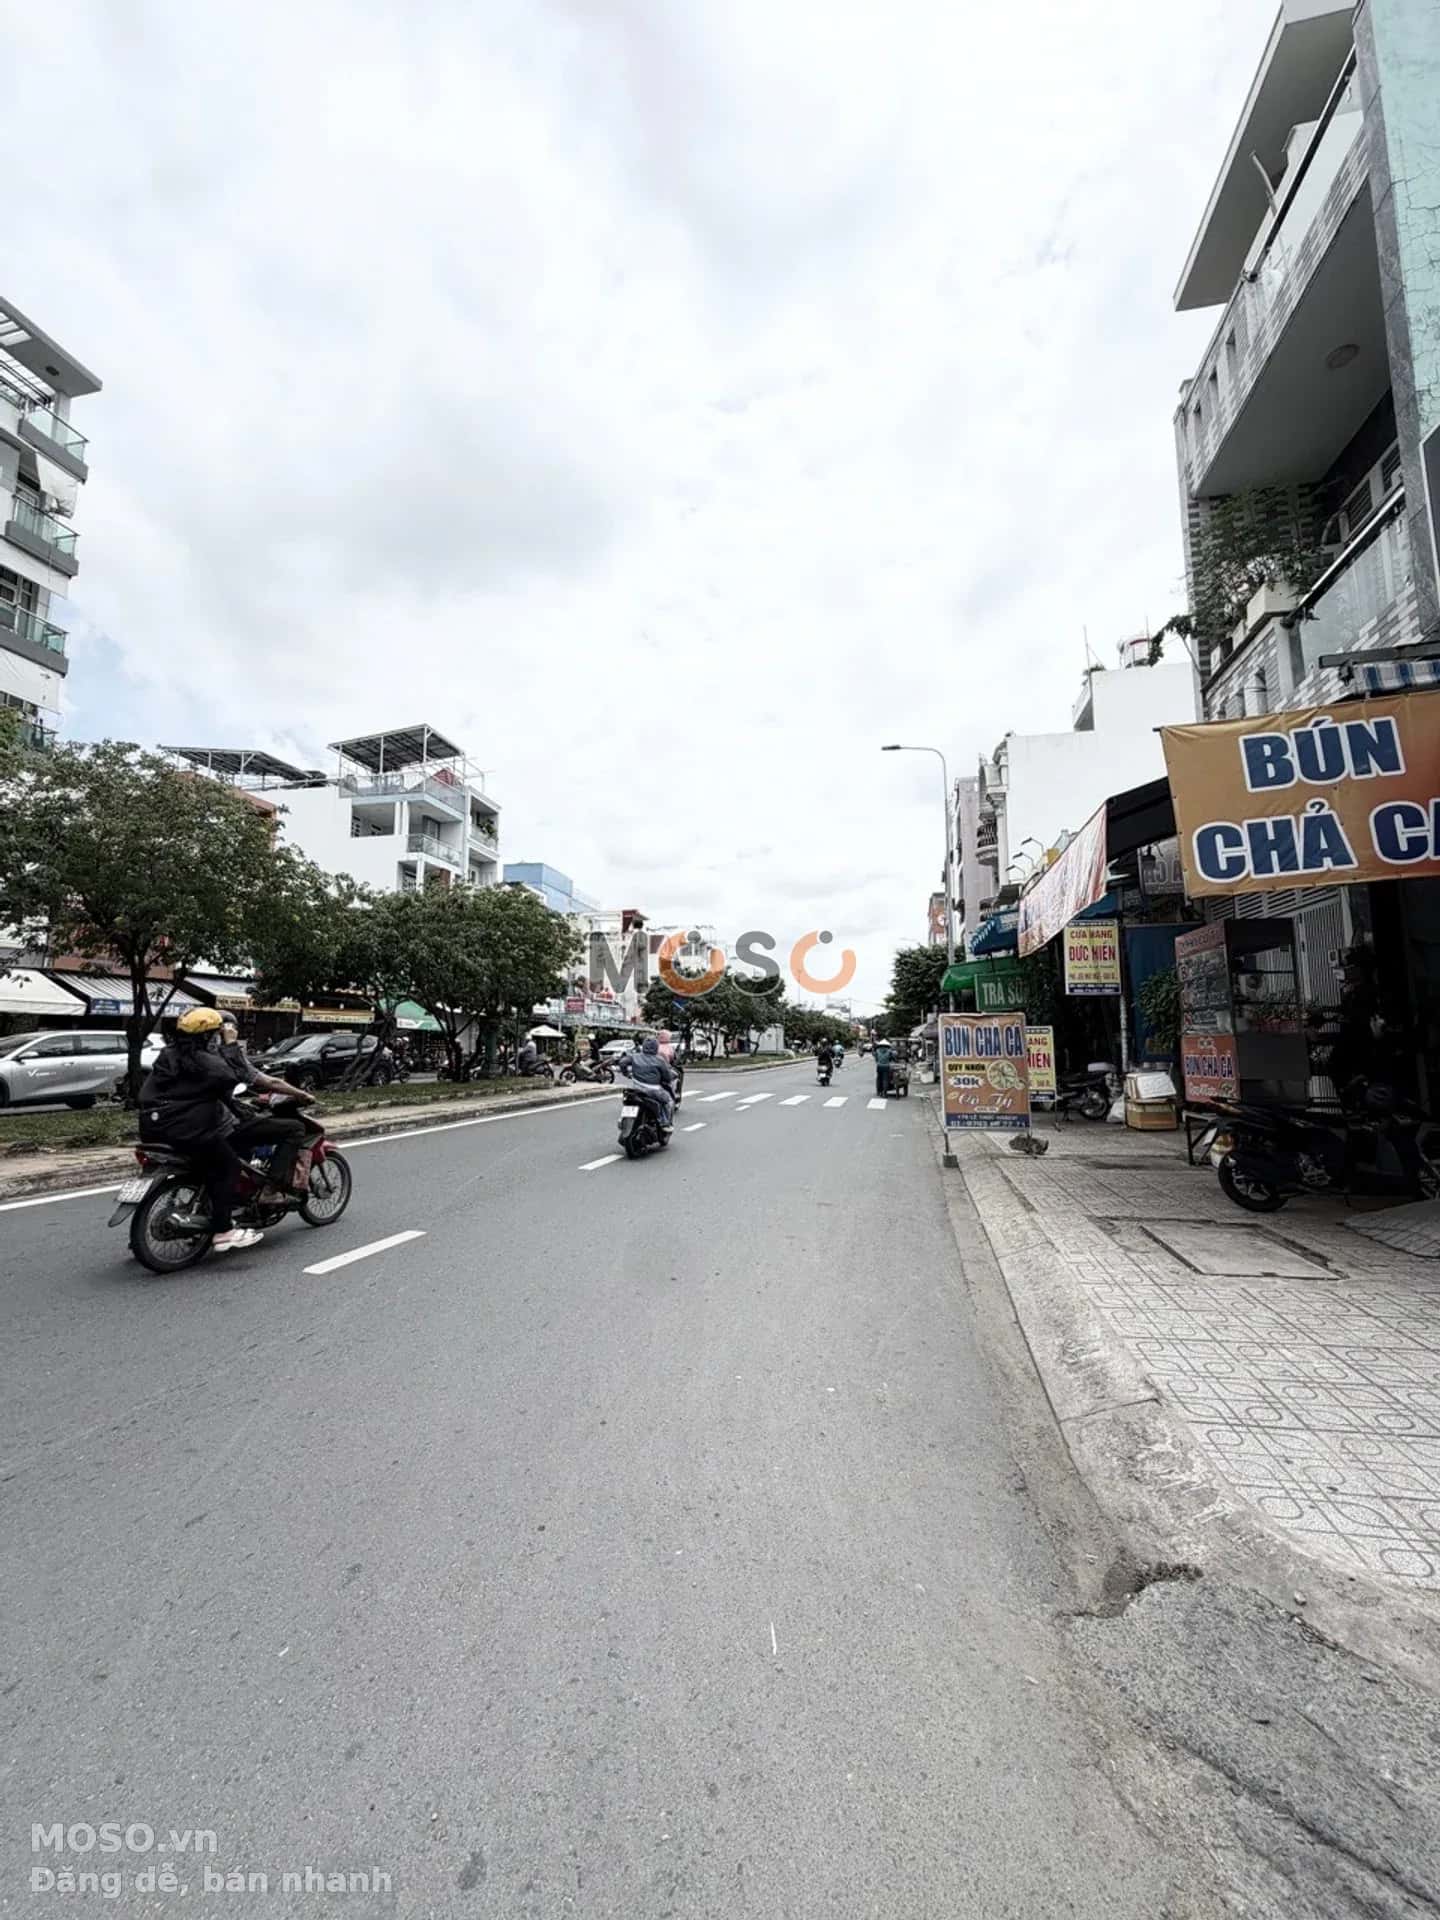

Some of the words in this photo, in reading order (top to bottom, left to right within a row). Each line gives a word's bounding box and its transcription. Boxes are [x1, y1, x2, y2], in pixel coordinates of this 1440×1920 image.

[1238, 716, 1406, 793] BÚN
[1192, 798, 1359, 884] CHẢ
[1369, 800, 1440, 865] C
[974, 1019, 1002, 1058] CHẢ
[1004, 1020, 1024, 1058] CÁ
